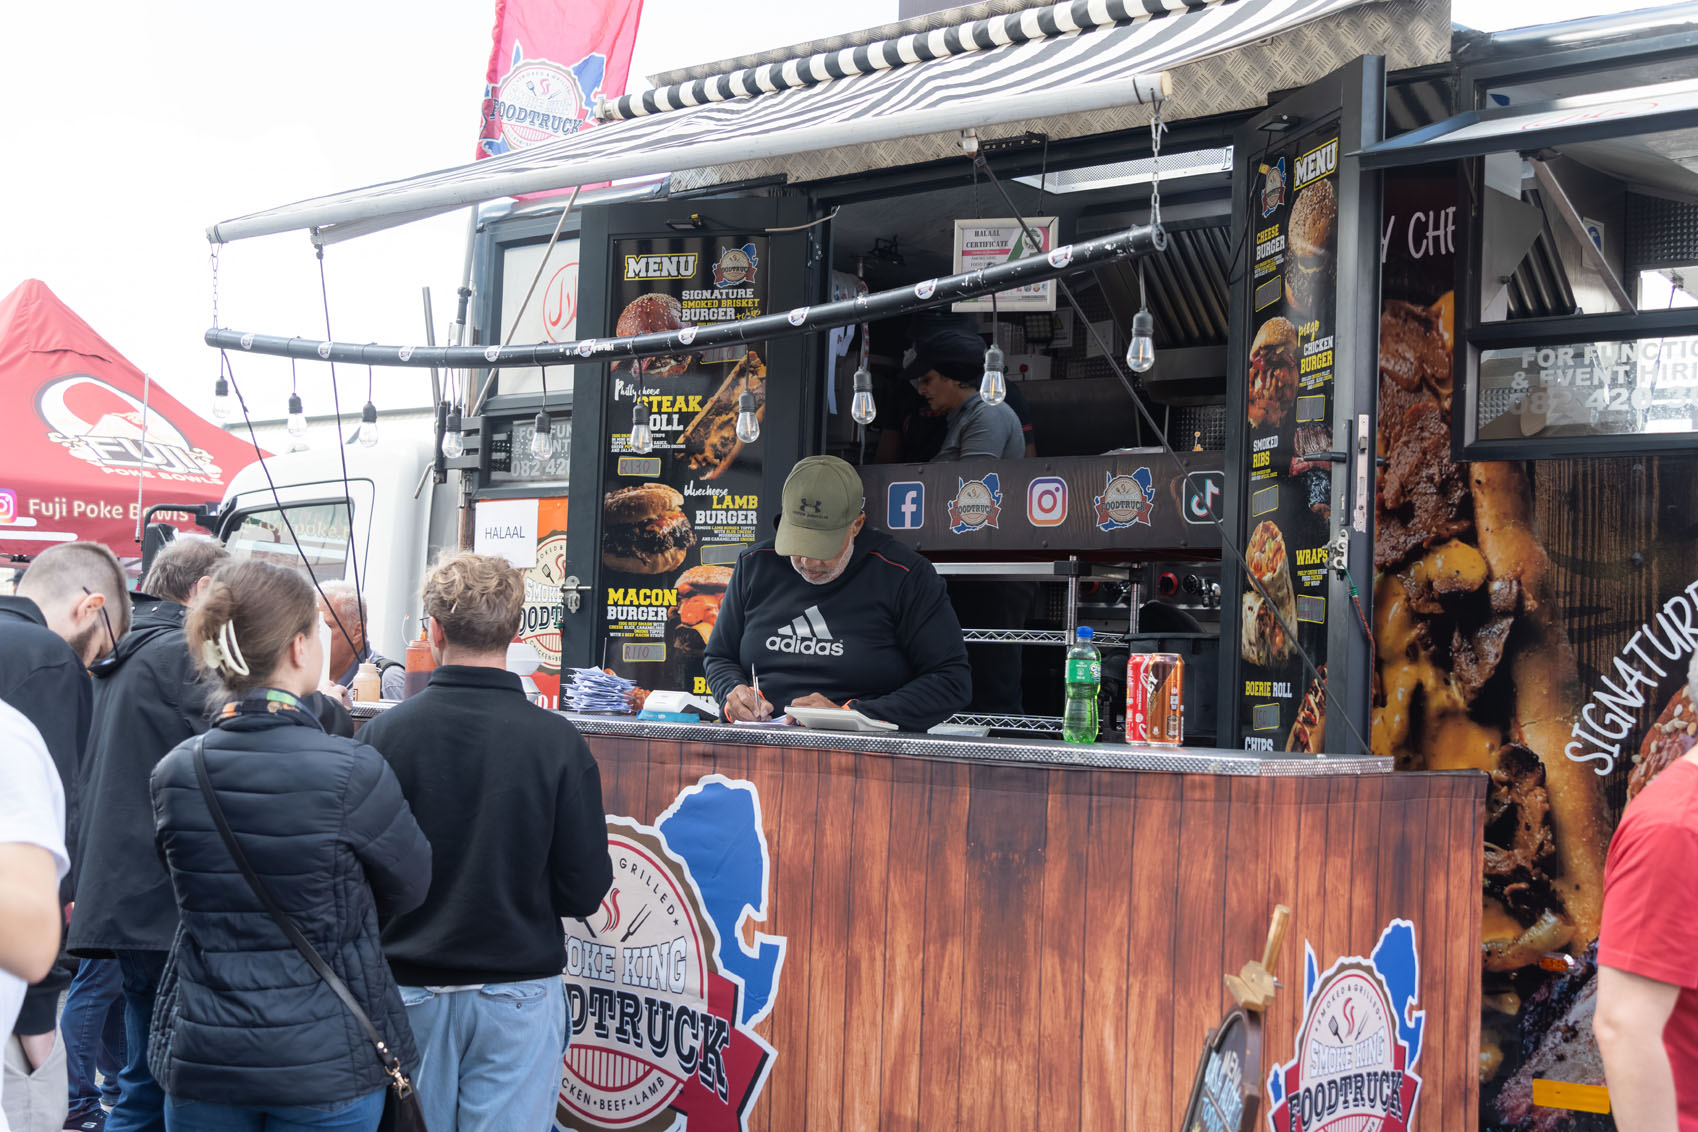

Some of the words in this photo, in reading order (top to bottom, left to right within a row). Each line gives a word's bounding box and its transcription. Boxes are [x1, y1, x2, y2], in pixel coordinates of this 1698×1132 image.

[489, 99, 582, 135] FOODTRUCK
[1295, 141, 1337, 187] MENU
[1256, 223, 1279, 244] CHEESE
[965, 240, 1008, 248] CERTIFICATE
[1256, 235, 1285, 260] BURGER
[626, 255, 695, 278] MENU
[682, 288, 754, 300] SIGNATURE
[682, 300, 718, 308] SMOKED
[721, 298, 760, 307] BRISKET
[681, 307, 736, 321] BURGER
[1303, 335, 1334, 356] CHICKEN
[1300, 350, 1333, 374] BURGER
[1521, 347, 1575, 368] FOR
[1511, 371, 1529, 390] &
[1540, 365, 1630, 388] EVENT
[614, 378, 637, 403] Philly
[649, 414, 684, 430] OLL
[520, 426, 536, 441] FO
[1253, 435, 1279, 452] SMOKED
[88, 436, 206, 475] FUJI
[1252, 451, 1270, 468] RIBS
[101, 467, 156, 478] POKE
[157, 472, 224, 485] BOWLS
[511, 460, 540, 477] 082
[29, 498, 66, 519] Fuji
[73, 501, 123, 519] Poke
[712, 495, 758, 509] LAMB
[954, 505, 994, 517] FOODTRUCK
[1101, 500, 1146, 513] FOODTRUCK
[695, 510, 757, 524] BURGER
[485, 526, 525, 540] HALAAL
[1296, 548, 1328, 565] WRAPS
[607, 588, 677, 606] MACON
[607, 606, 668, 621] BURGER
[765, 635, 844, 657] adidas
[1245, 681, 1271, 696] BOERIE
[1272, 681, 1292, 698] ROLL
[1244, 736, 1274, 751] CHIPS
[619, 857, 675, 916] GRILLED
[563, 933, 616, 984] OKE
[622, 935, 688, 994] KING
[566, 983, 730, 1105] DTRUCK
[1310, 1038, 1353, 1079] SMOKE
[1355, 1025, 1385, 1069] KING
[562, 1077, 591, 1107] CKEN
[600, 1099, 627, 1112] BEEF
[635, 1075, 665, 1107] LAMB
[1288, 1070, 1403, 1132] FOODTRUCK
